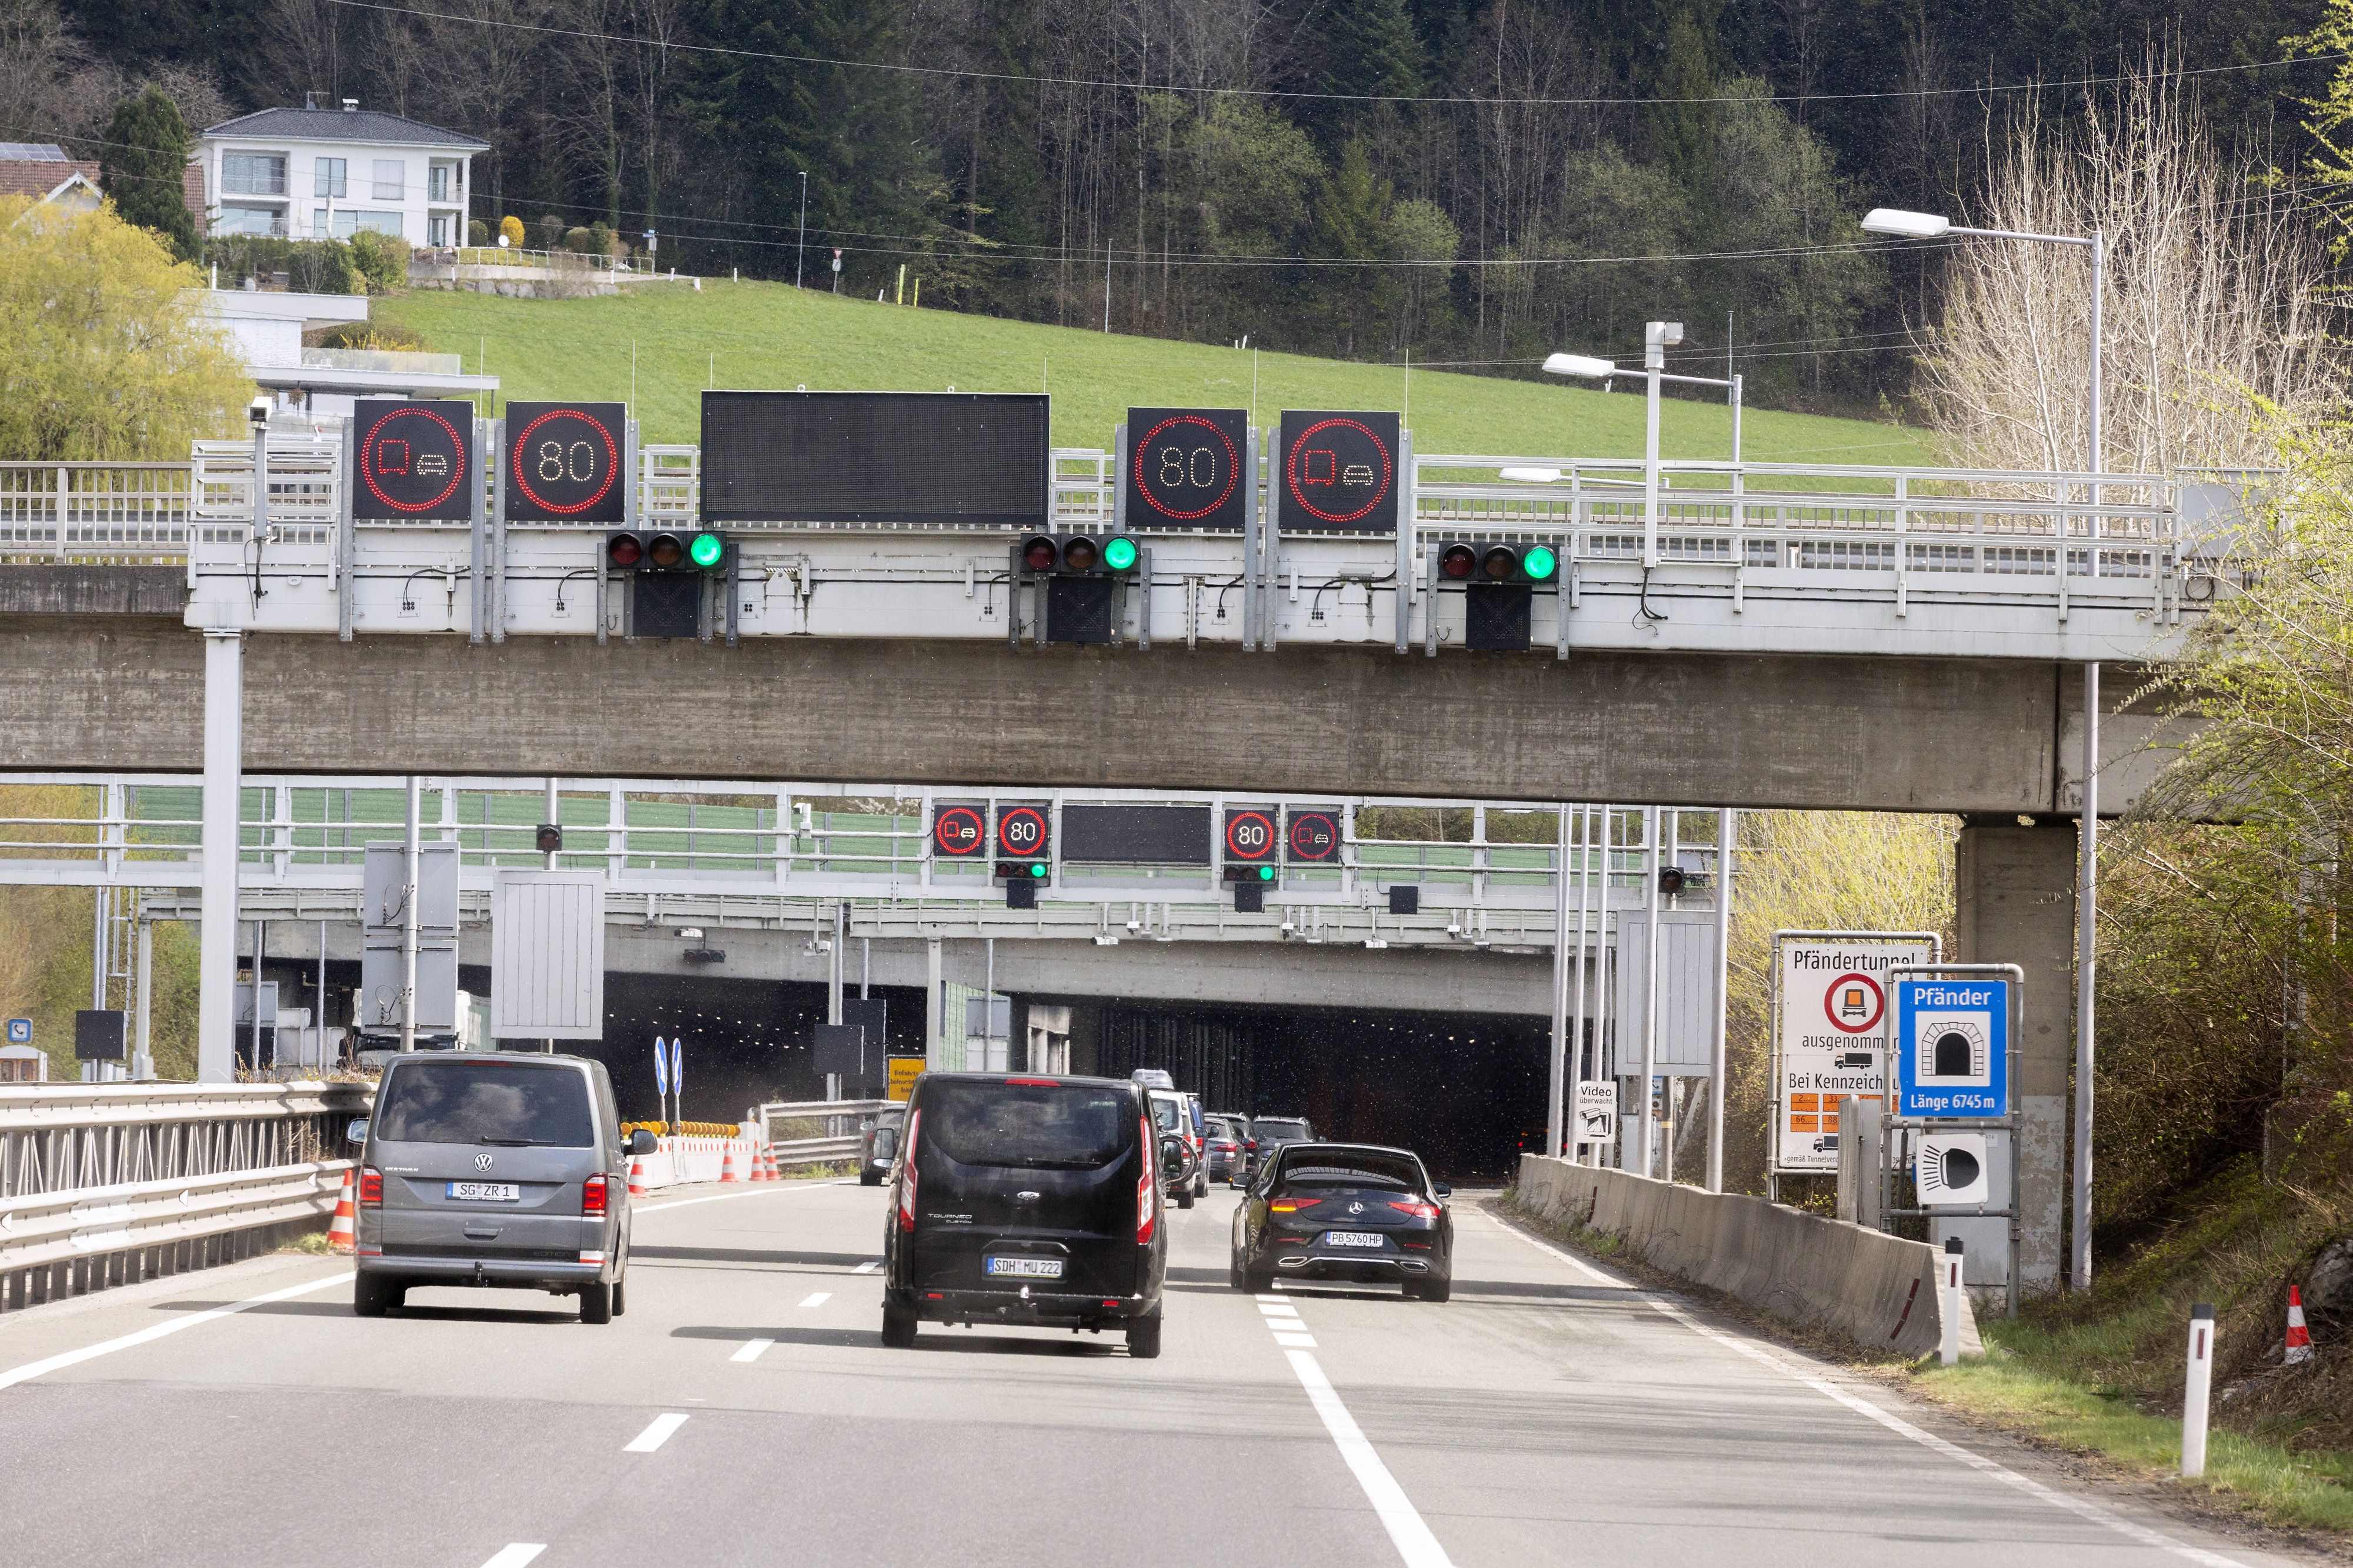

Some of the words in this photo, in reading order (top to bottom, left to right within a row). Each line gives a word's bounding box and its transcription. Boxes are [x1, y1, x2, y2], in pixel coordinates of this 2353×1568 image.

[538, 441, 594, 482] 80
[1159, 446, 1216, 488] 80
[1010, 822, 1036, 842] 80
[1238, 825, 1264, 845] 80
[1914, 987, 1992, 1005] Pfänder
[1789, 1072, 1809, 1089] Bei
[1581, 1086, 1612, 1096] Video
[1911, 1095, 1949, 1110] Länge
[1952, 1095, 1982, 1108] 6745
[1983, 1097, 1995, 1108] m
[460, 1185, 475, 1195] SG
[484, 1185, 499, 1196] ZR
[503, 1186, 509, 1197] 1
[1332, 1233, 1344, 1242] PB
[1346, 1234, 1368, 1243] 5760
[1369, 1235, 1382, 1244] HP
[995, 1260, 1016, 1272] SDH
[1024, 1262, 1037, 1273] MU
[1040, 1262, 1059, 1275] 222
